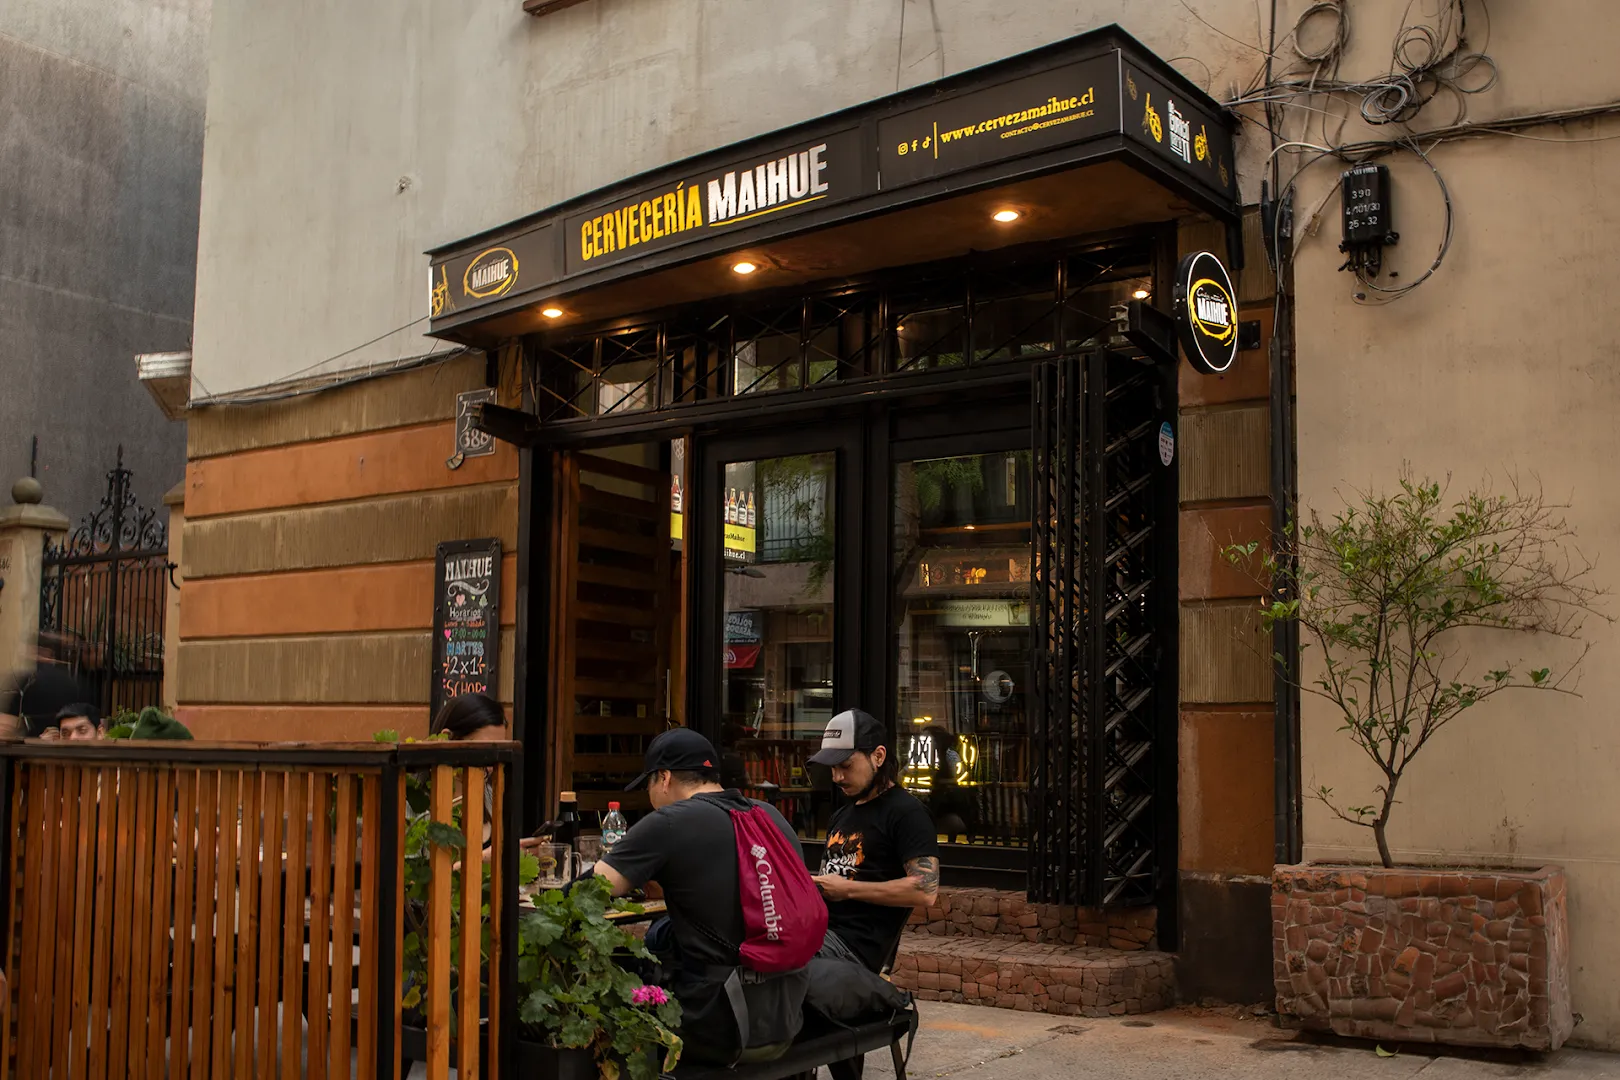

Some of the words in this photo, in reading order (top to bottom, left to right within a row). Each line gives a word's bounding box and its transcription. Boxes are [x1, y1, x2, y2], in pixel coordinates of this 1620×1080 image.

[940, 87, 1095, 144] www.cervezamaihue.cl
[581, 181, 702, 261] CERVECERÍA
[707, 143, 829, 224] MAIHUE
[1352, 188, 1371, 199] 390
[1348, 219, 1360, 230] 25
[1367, 215, 1378, 226] 32
[472, 259, 509, 290] MAIHUE
[445, 556, 492, 581] MAIHUE
[446, 641, 485, 657] MARTES
[449, 655, 479, 675] 2x1
[755, 859, 783, 941] Columbia
